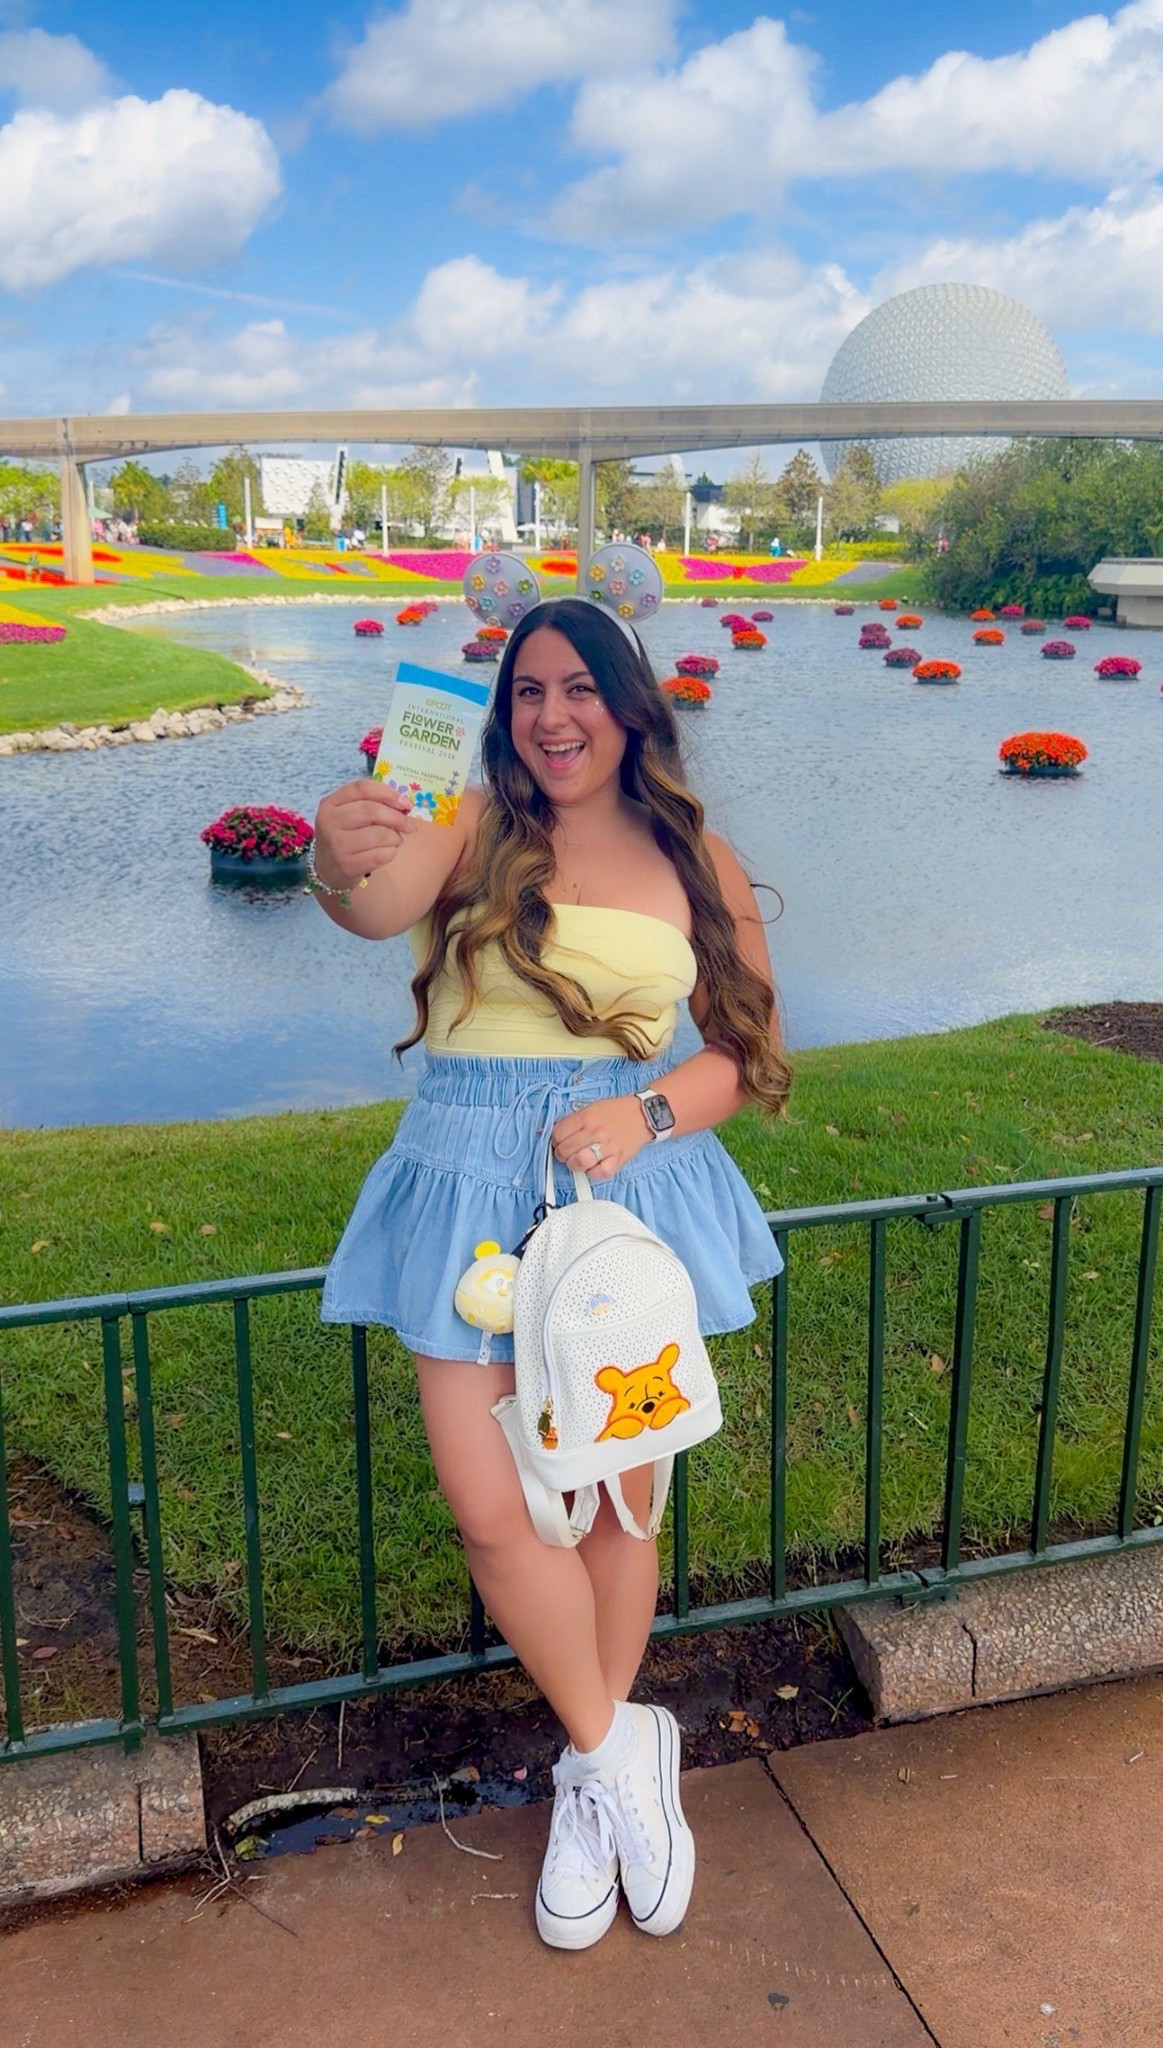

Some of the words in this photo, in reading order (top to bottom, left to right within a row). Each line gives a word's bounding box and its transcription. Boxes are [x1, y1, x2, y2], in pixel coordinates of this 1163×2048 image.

[408, 704, 464, 724] INTERNATIONAL
[426, 698, 452, 711] EPCOT
[402, 711, 454, 735] FLOWER
[399, 724, 461, 751] GARDEN
[400, 740, 435, 754] FESTIVAL
